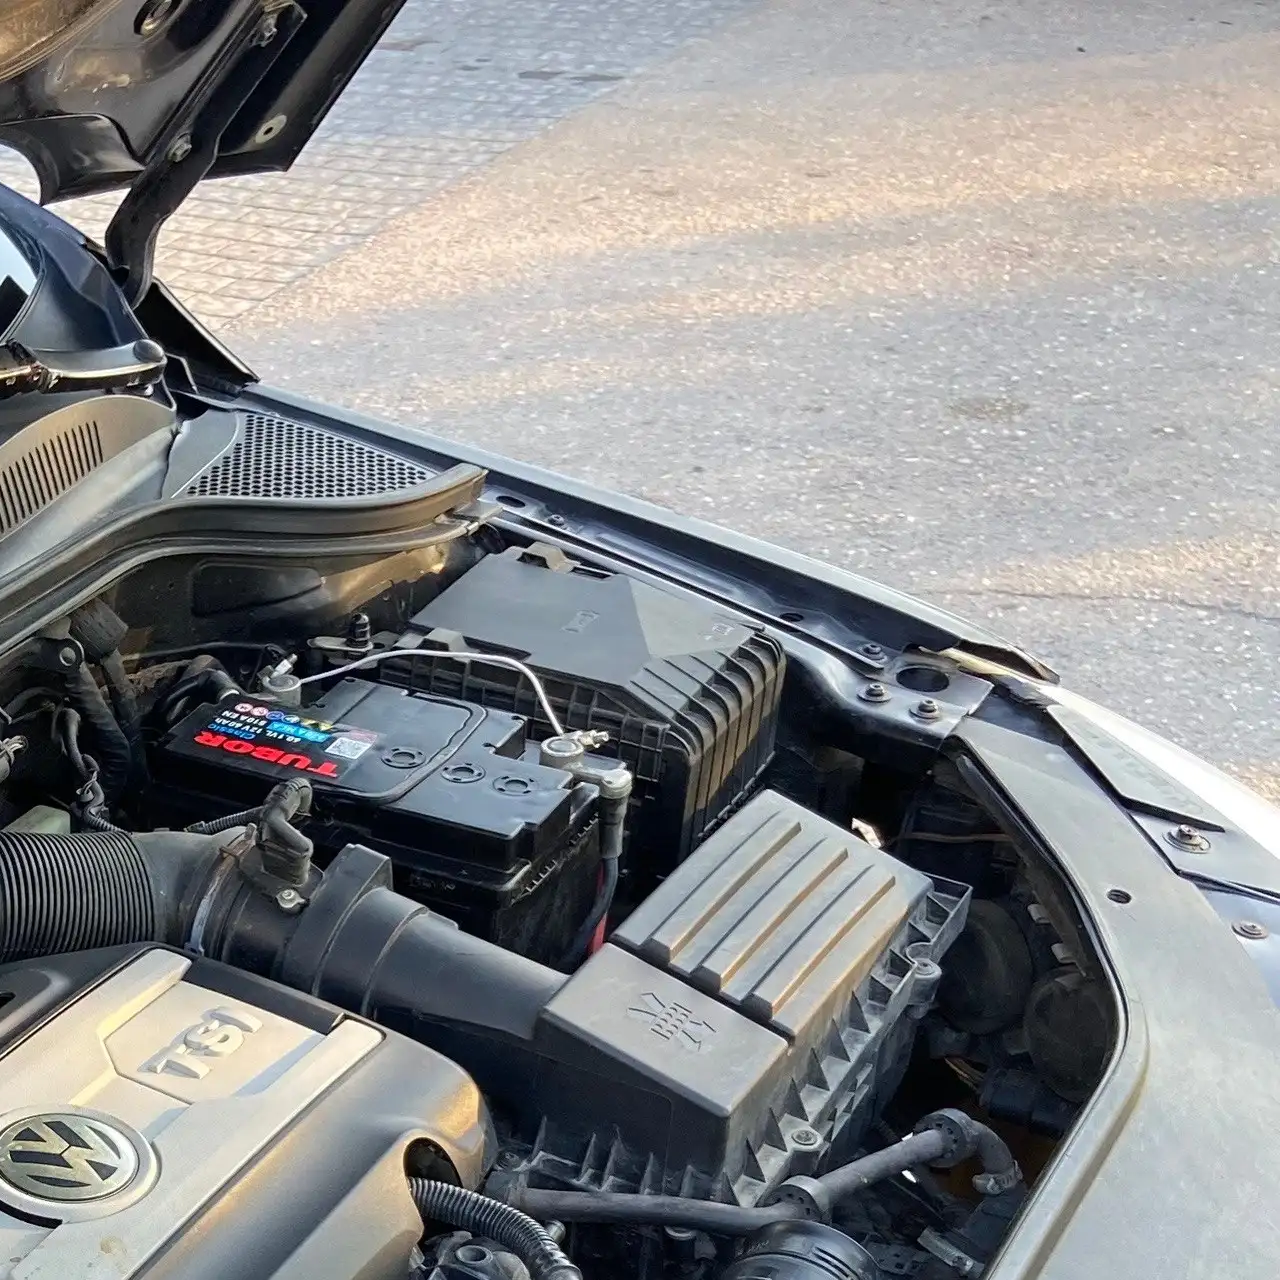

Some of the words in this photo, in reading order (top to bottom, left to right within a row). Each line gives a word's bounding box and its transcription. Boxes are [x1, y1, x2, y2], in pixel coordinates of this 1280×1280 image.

[221, 710, 240, 719] EN
[207, 723, 256, 740] Classic
[240, 725, 263, 734] 12V
[194, 731, 338, 778] TUBOR
[143, 1006, 263, 1079] TSI
